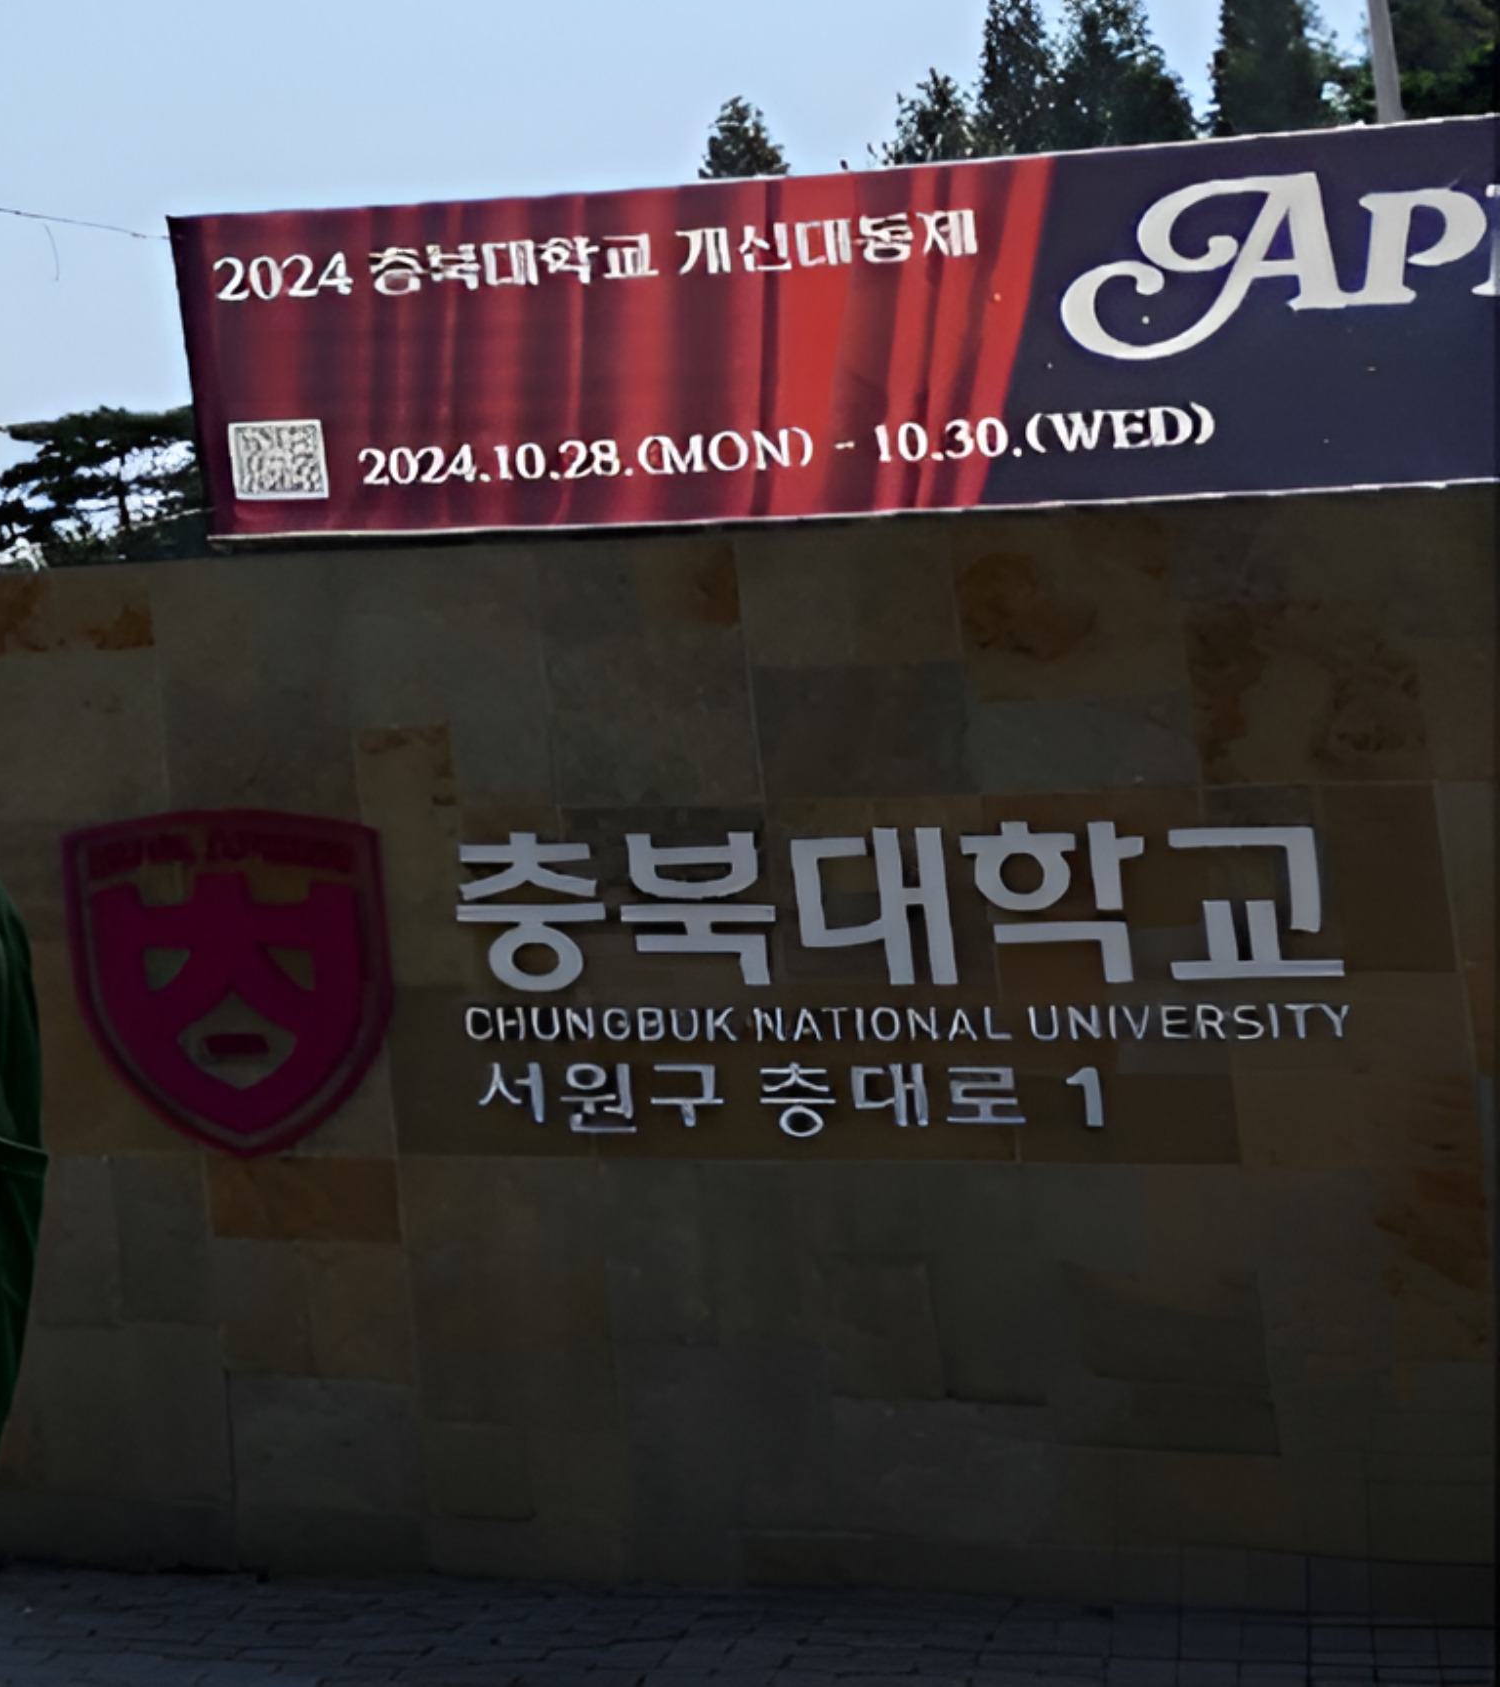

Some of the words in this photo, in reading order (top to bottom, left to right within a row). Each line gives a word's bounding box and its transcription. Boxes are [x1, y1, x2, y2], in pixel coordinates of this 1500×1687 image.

[213, 252, 354, 302] 2024
[369, 233, 660, 296] 충북대학교
[675, 208, 980, 276] 개신대동제
[456, 820, 1346, 993] 충북대학교
[464, 1006, 738, 1042] CHUNGBUK
[751, 1005, 1013, 1042] NATIONAL
[1028, 1002, 1350, 1041] UNIVERSITY
[478, 1061, 725, 1134] 서원구
[759, 1061, 1027, 1138] 충대로
[1065, 1066, 1105, 1128] 1
